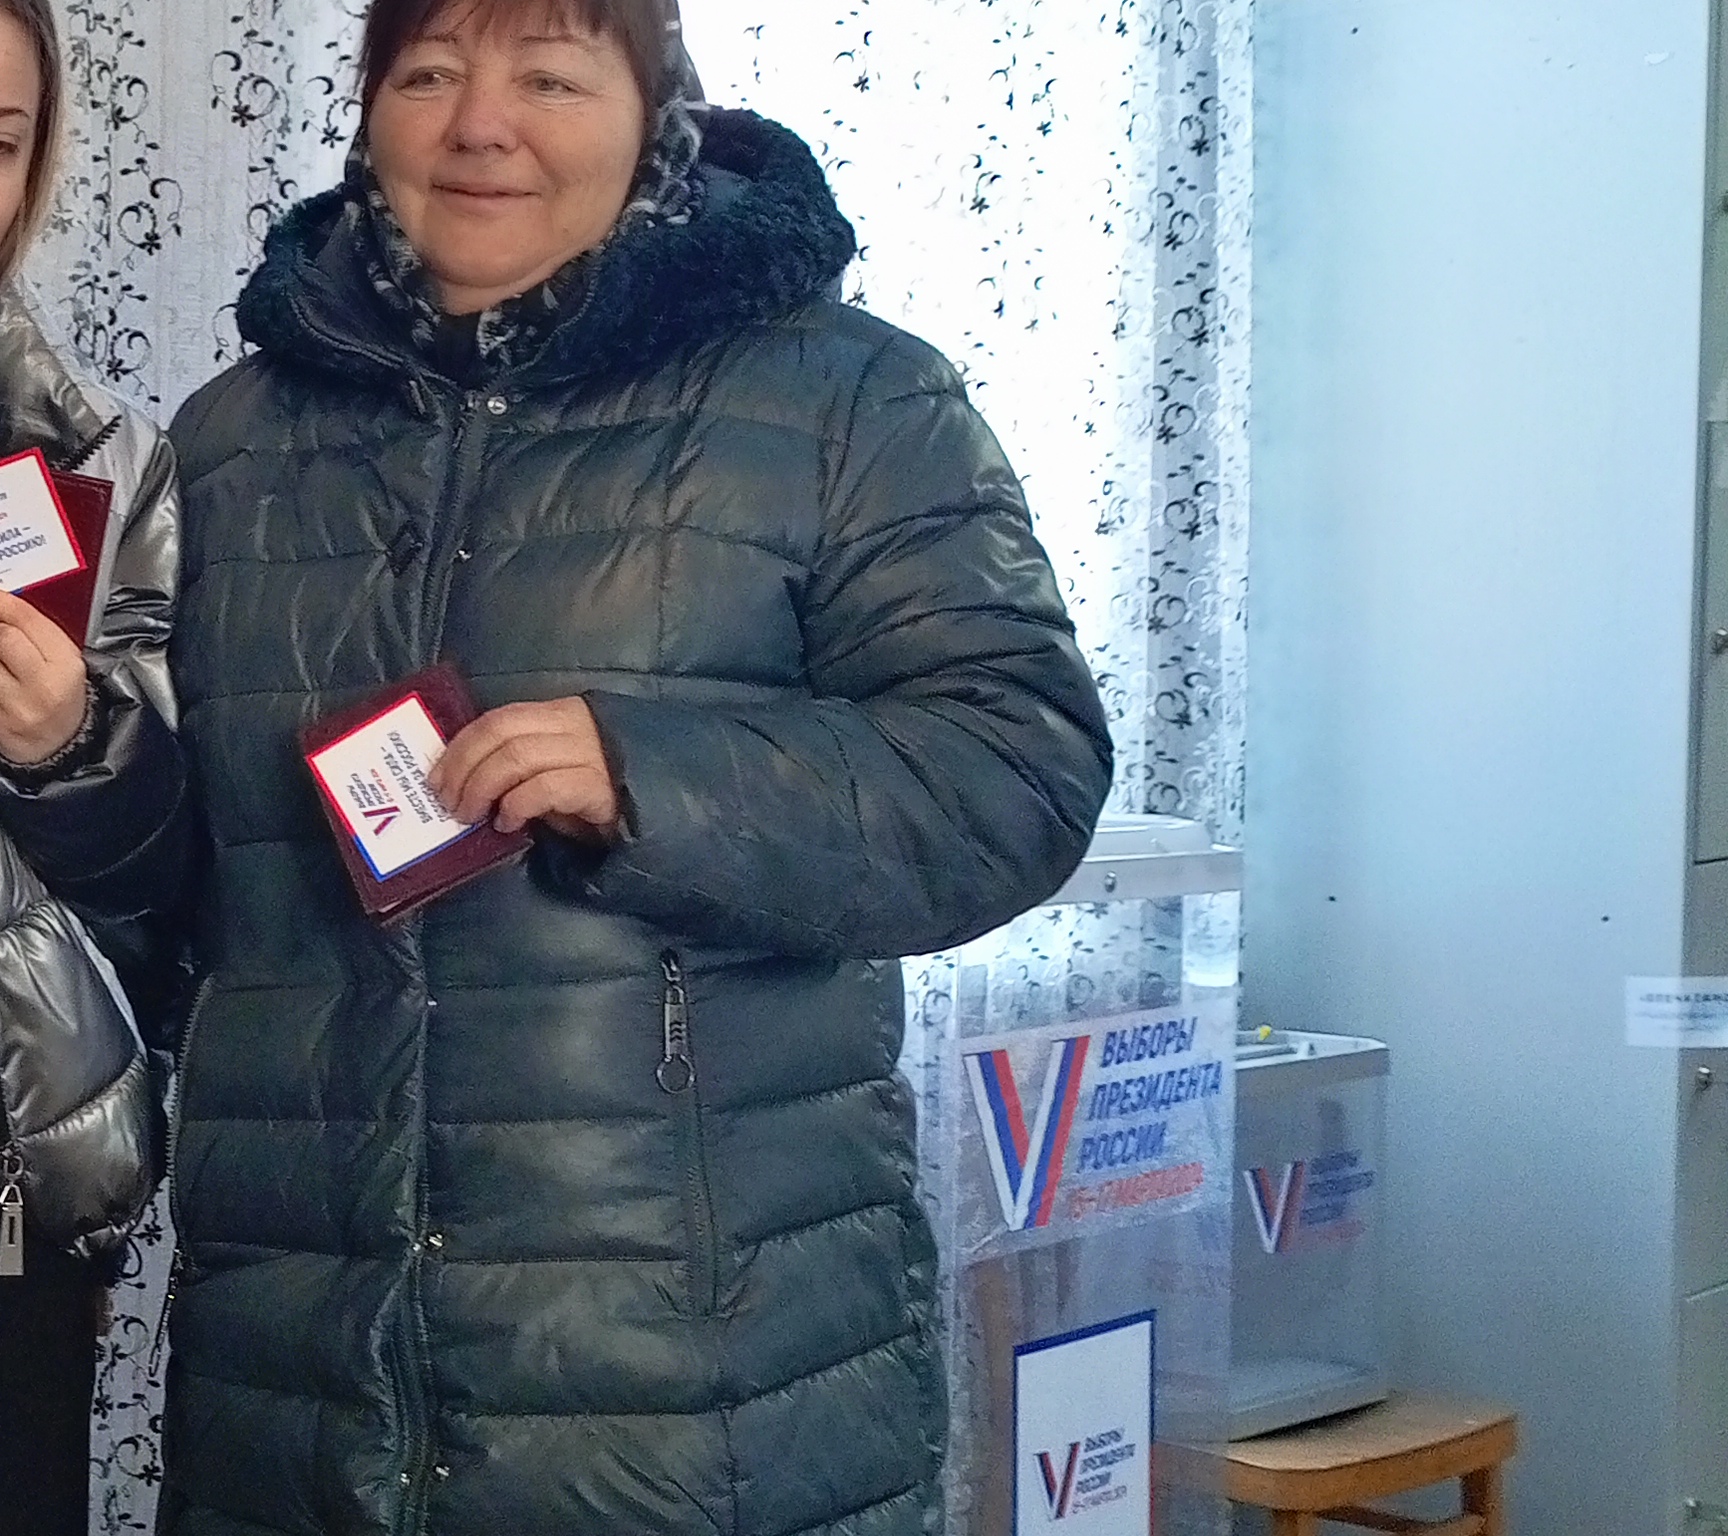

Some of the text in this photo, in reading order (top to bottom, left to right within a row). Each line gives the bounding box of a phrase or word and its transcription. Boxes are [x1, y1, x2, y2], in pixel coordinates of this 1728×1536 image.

[1100, 1017, 1198, 1068] ВЫБОРЫ
[1087, 1061, 1223, 1122] ПРЕЗИДЕНТА
[1076, 1121, 1168, 1173] РОССИИ
